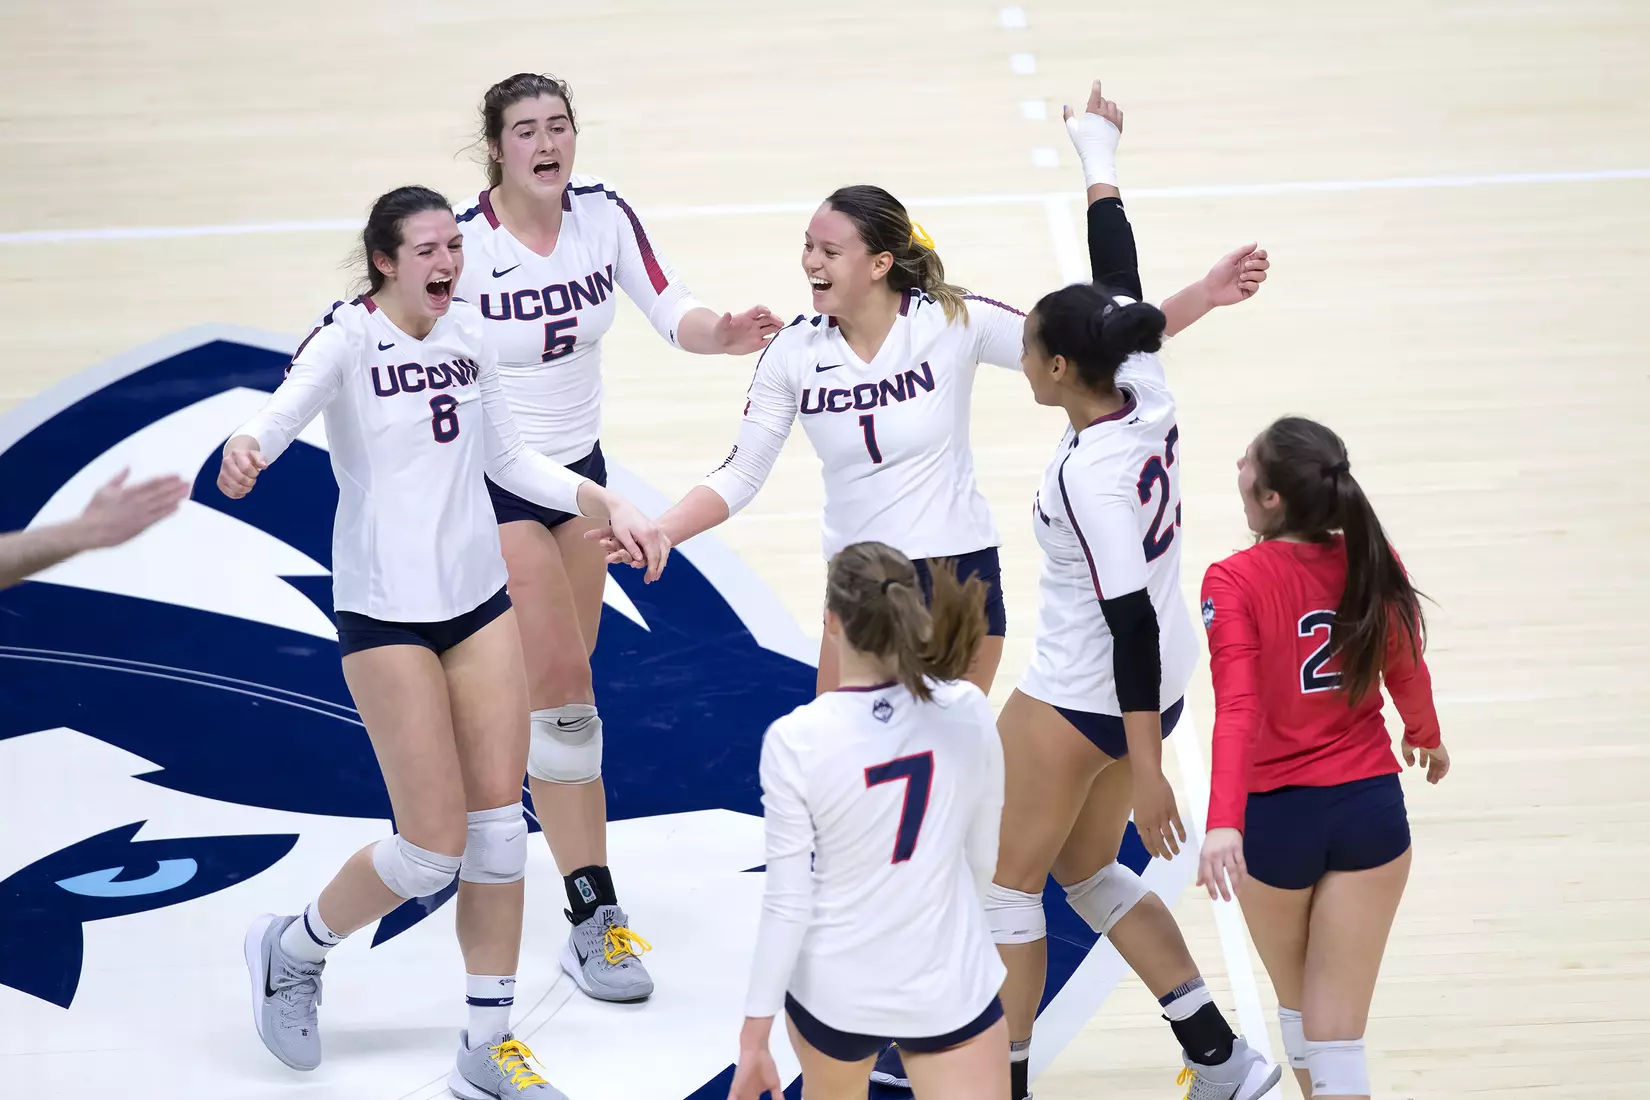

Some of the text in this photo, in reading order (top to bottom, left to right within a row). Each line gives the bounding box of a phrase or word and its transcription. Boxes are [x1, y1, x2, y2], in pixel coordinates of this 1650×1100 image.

[480, 264, 613, 321] UCONN
[541, 317, 578, 362] 5
[371, 358, 479, 397] UCONN
[800, 361, 936, 414] UCONN
[429, 394, 459, 443] 8
[859, 414, 882, 464] 1
[864, 750, 935, 864] 7
